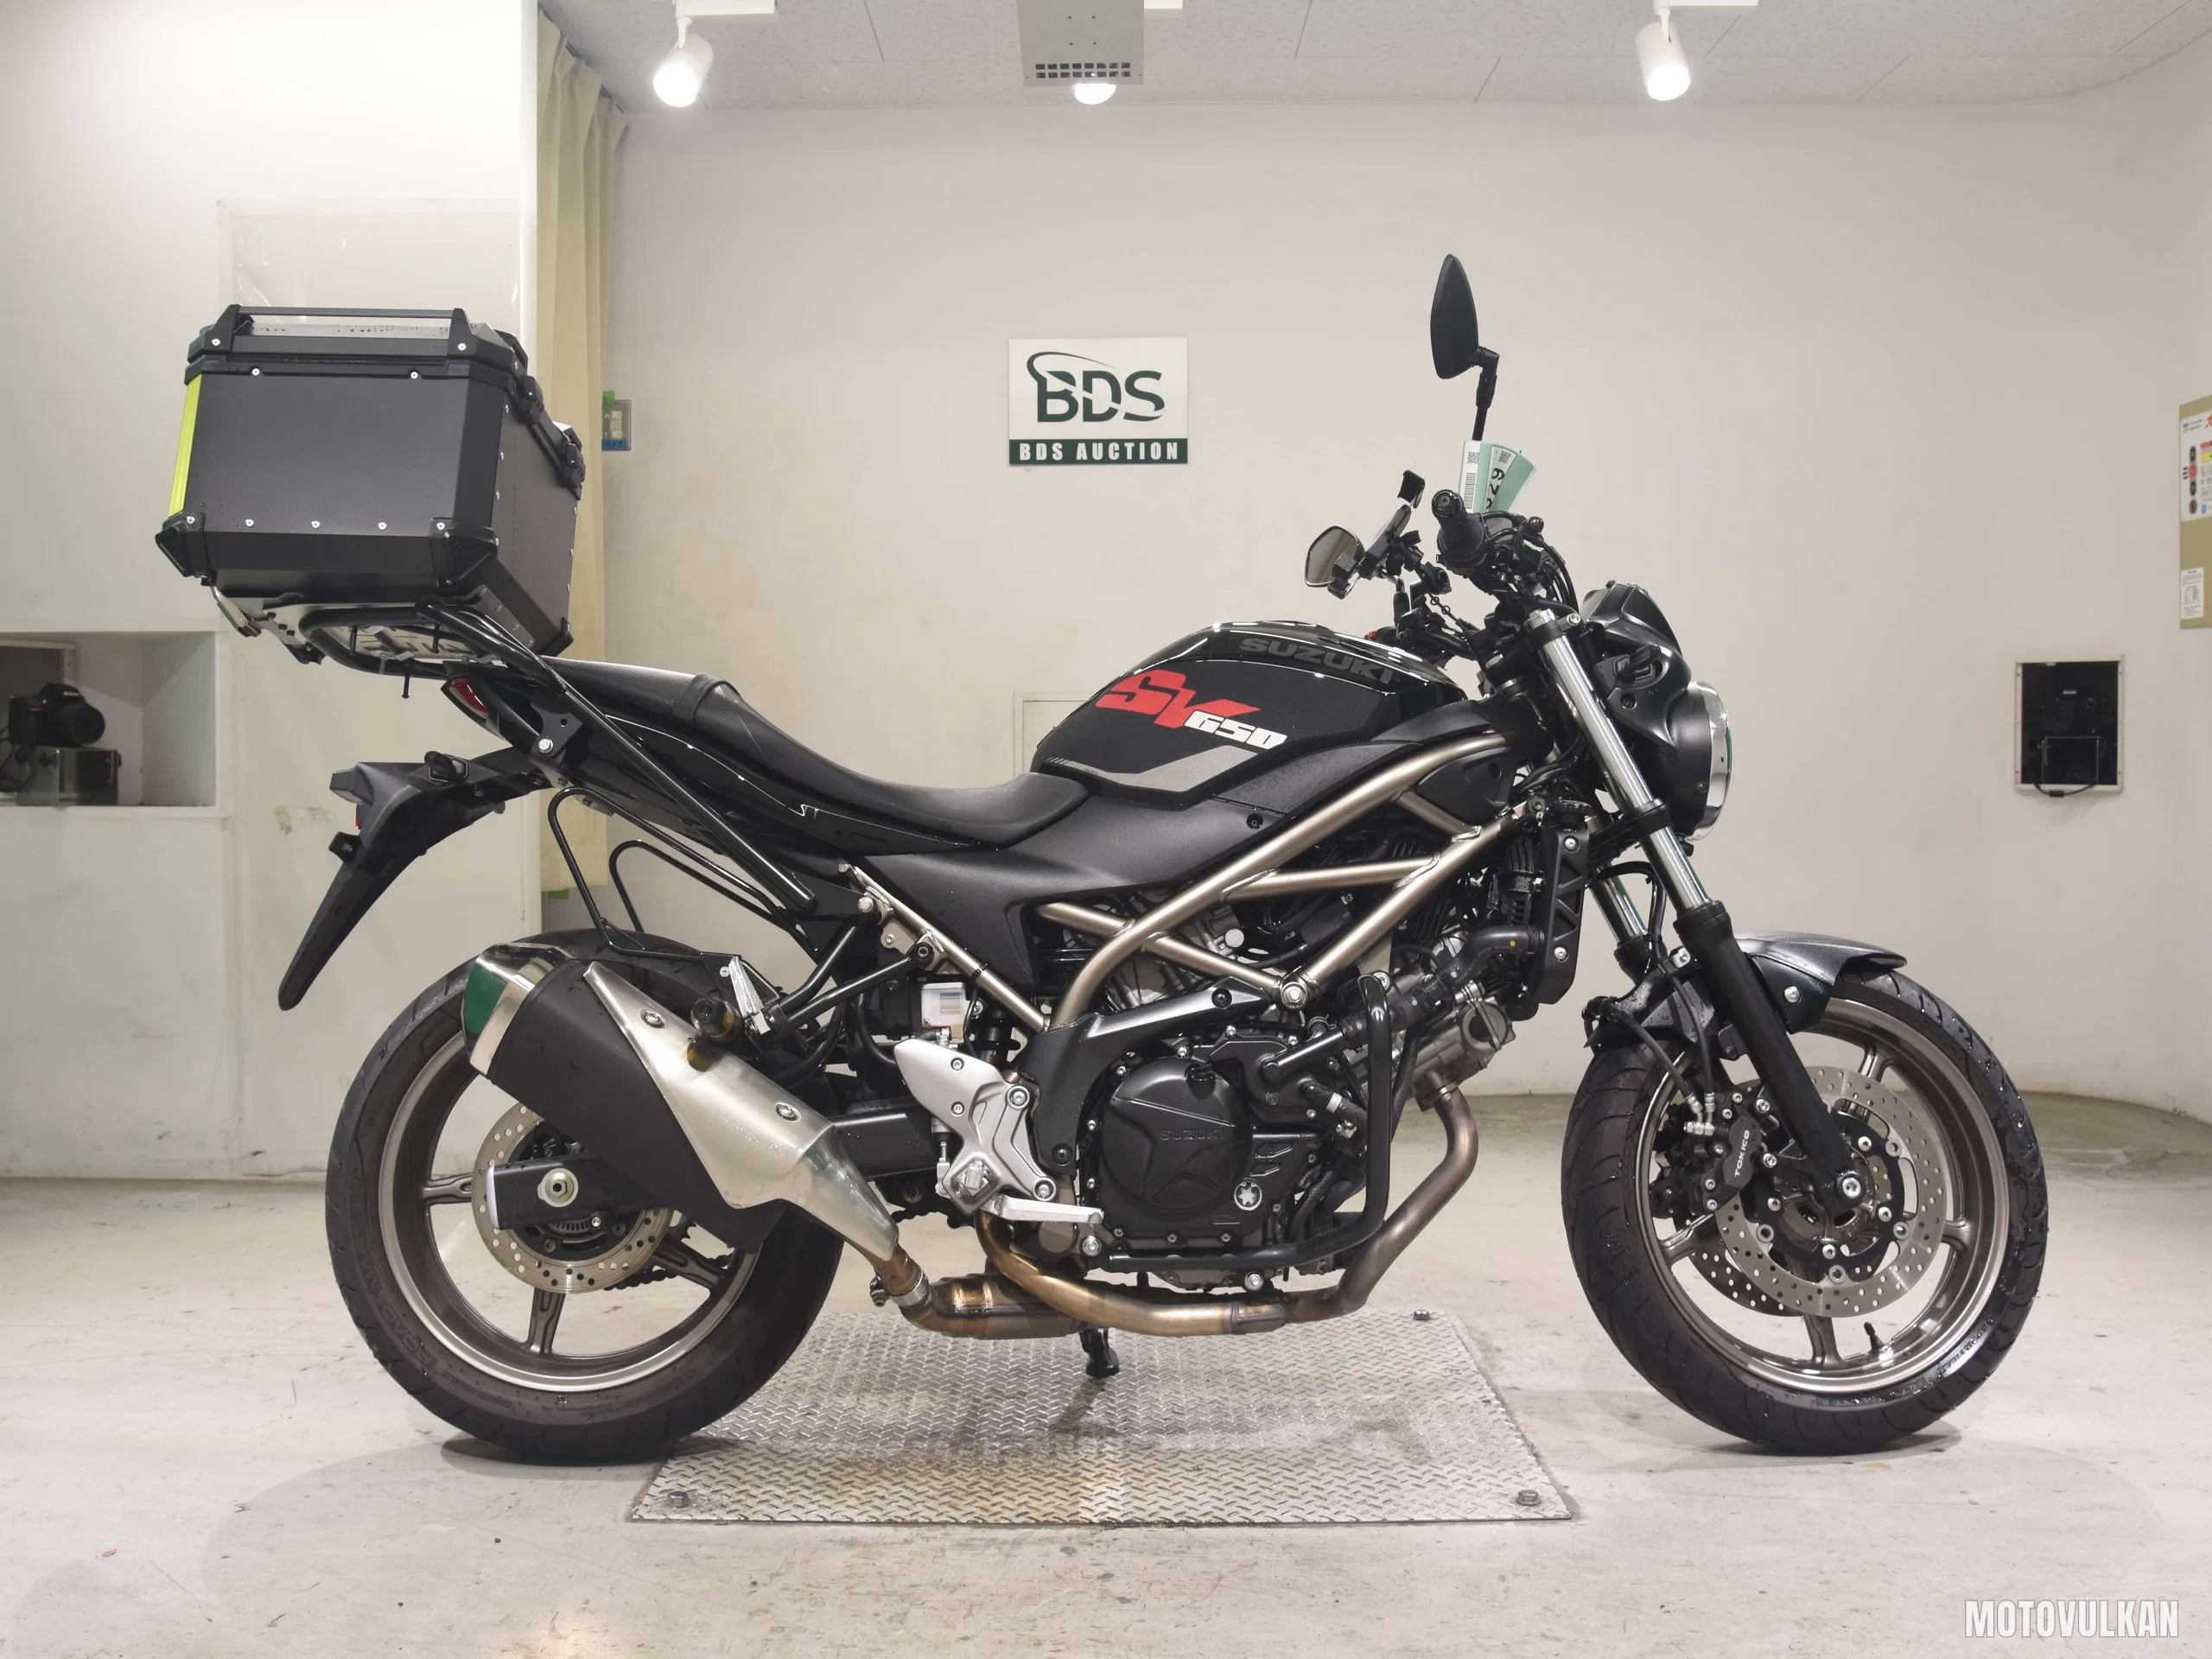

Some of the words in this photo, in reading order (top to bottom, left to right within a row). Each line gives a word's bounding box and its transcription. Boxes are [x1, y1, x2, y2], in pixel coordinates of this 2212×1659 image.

[1027, 352, 1166, 423] BDS
[1019, 442, 1064, 461] BDS
[1076, 442, 1179, 461] AUCTION
[1239, 638, 1394, 684] SUZUKI
[1095, 669, 1262, 728] SV
[1183, 709, 1288, 750] 650
[1158, 1127, 1224, 1141] SUZUKI
[1734, 1129, 1751, 1177] TOKICO
